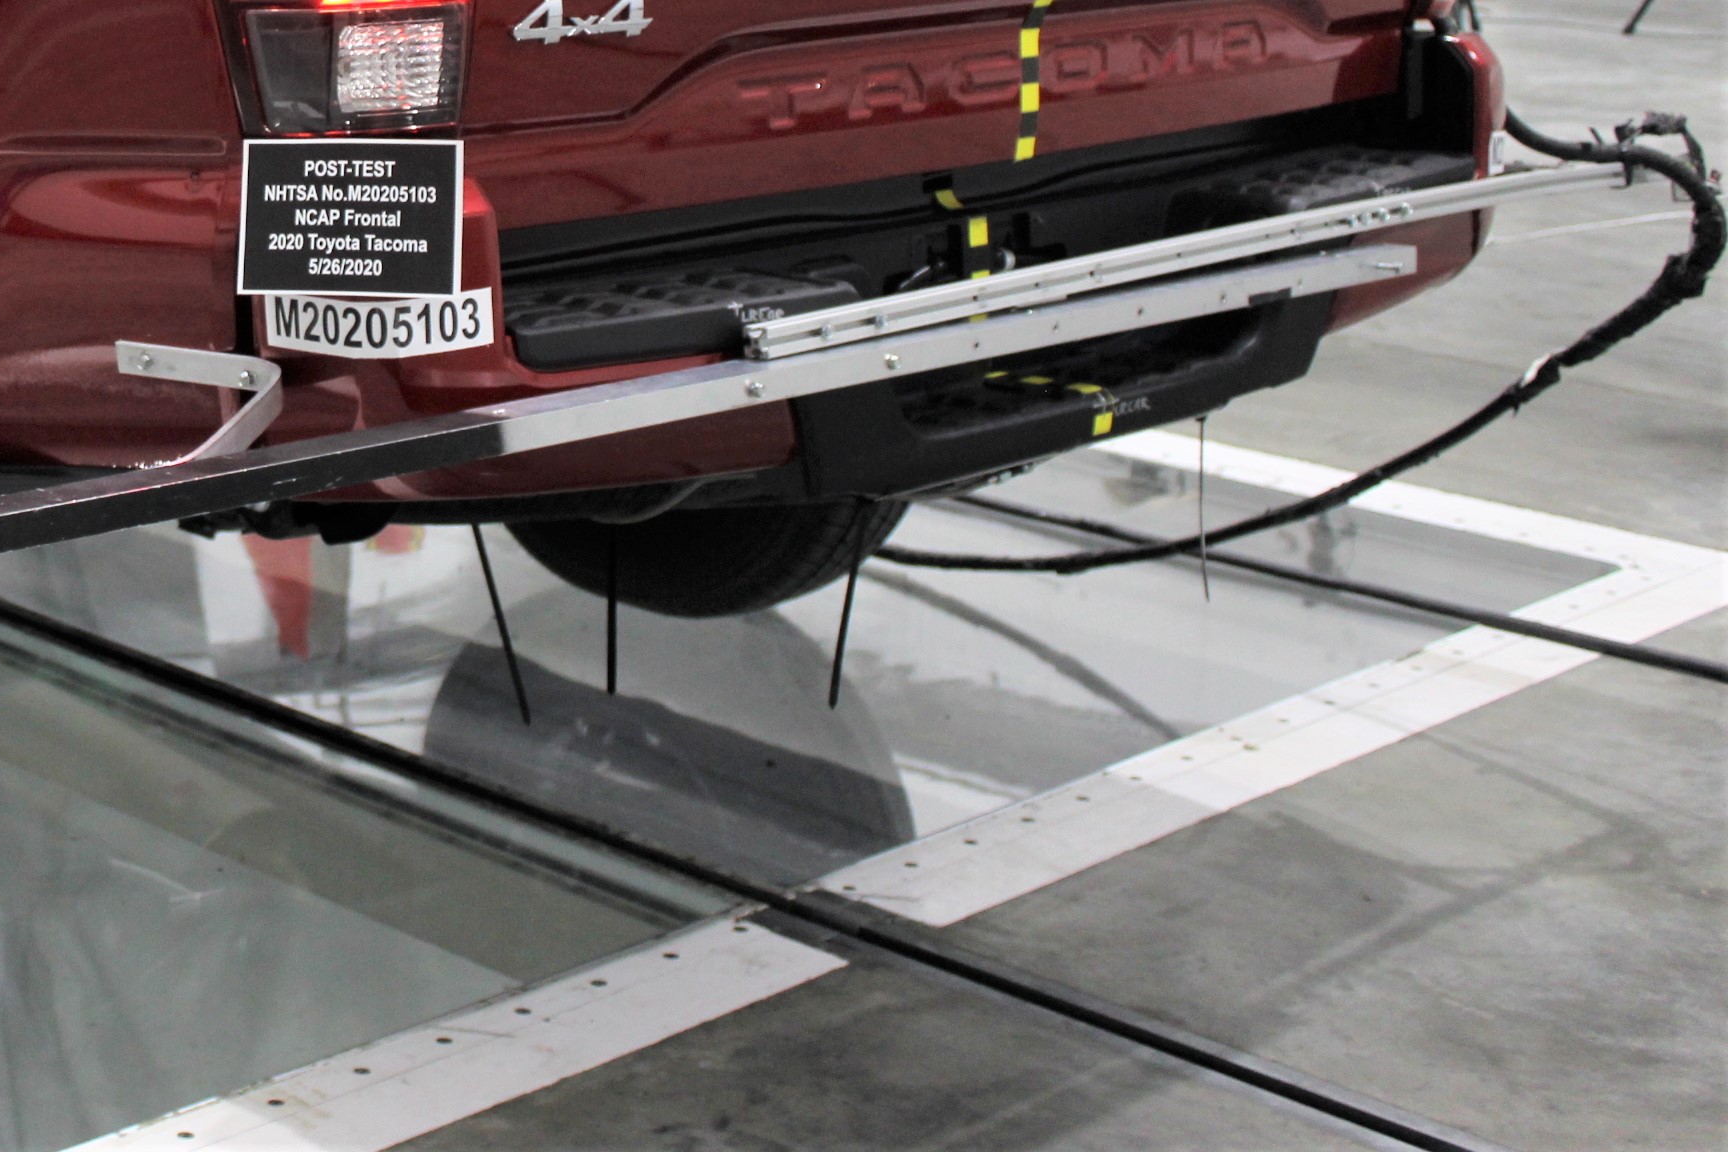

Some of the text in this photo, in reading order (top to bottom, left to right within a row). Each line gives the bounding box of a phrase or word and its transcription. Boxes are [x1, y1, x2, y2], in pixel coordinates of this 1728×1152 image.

[736, 19, 1269, 130] TACOMA
[304, 160, 396, 178] POST-TEST
[264, 184, 437, 204] NHTSA No.M20205103
[294, 208, 402, 228] NCAP Frontal
[268, 232, 428, 255] 2020 Toyota Tacoma
[308, 257, 383, 277] 5/26/2020
[274, 296, 480, 349] M20205103
